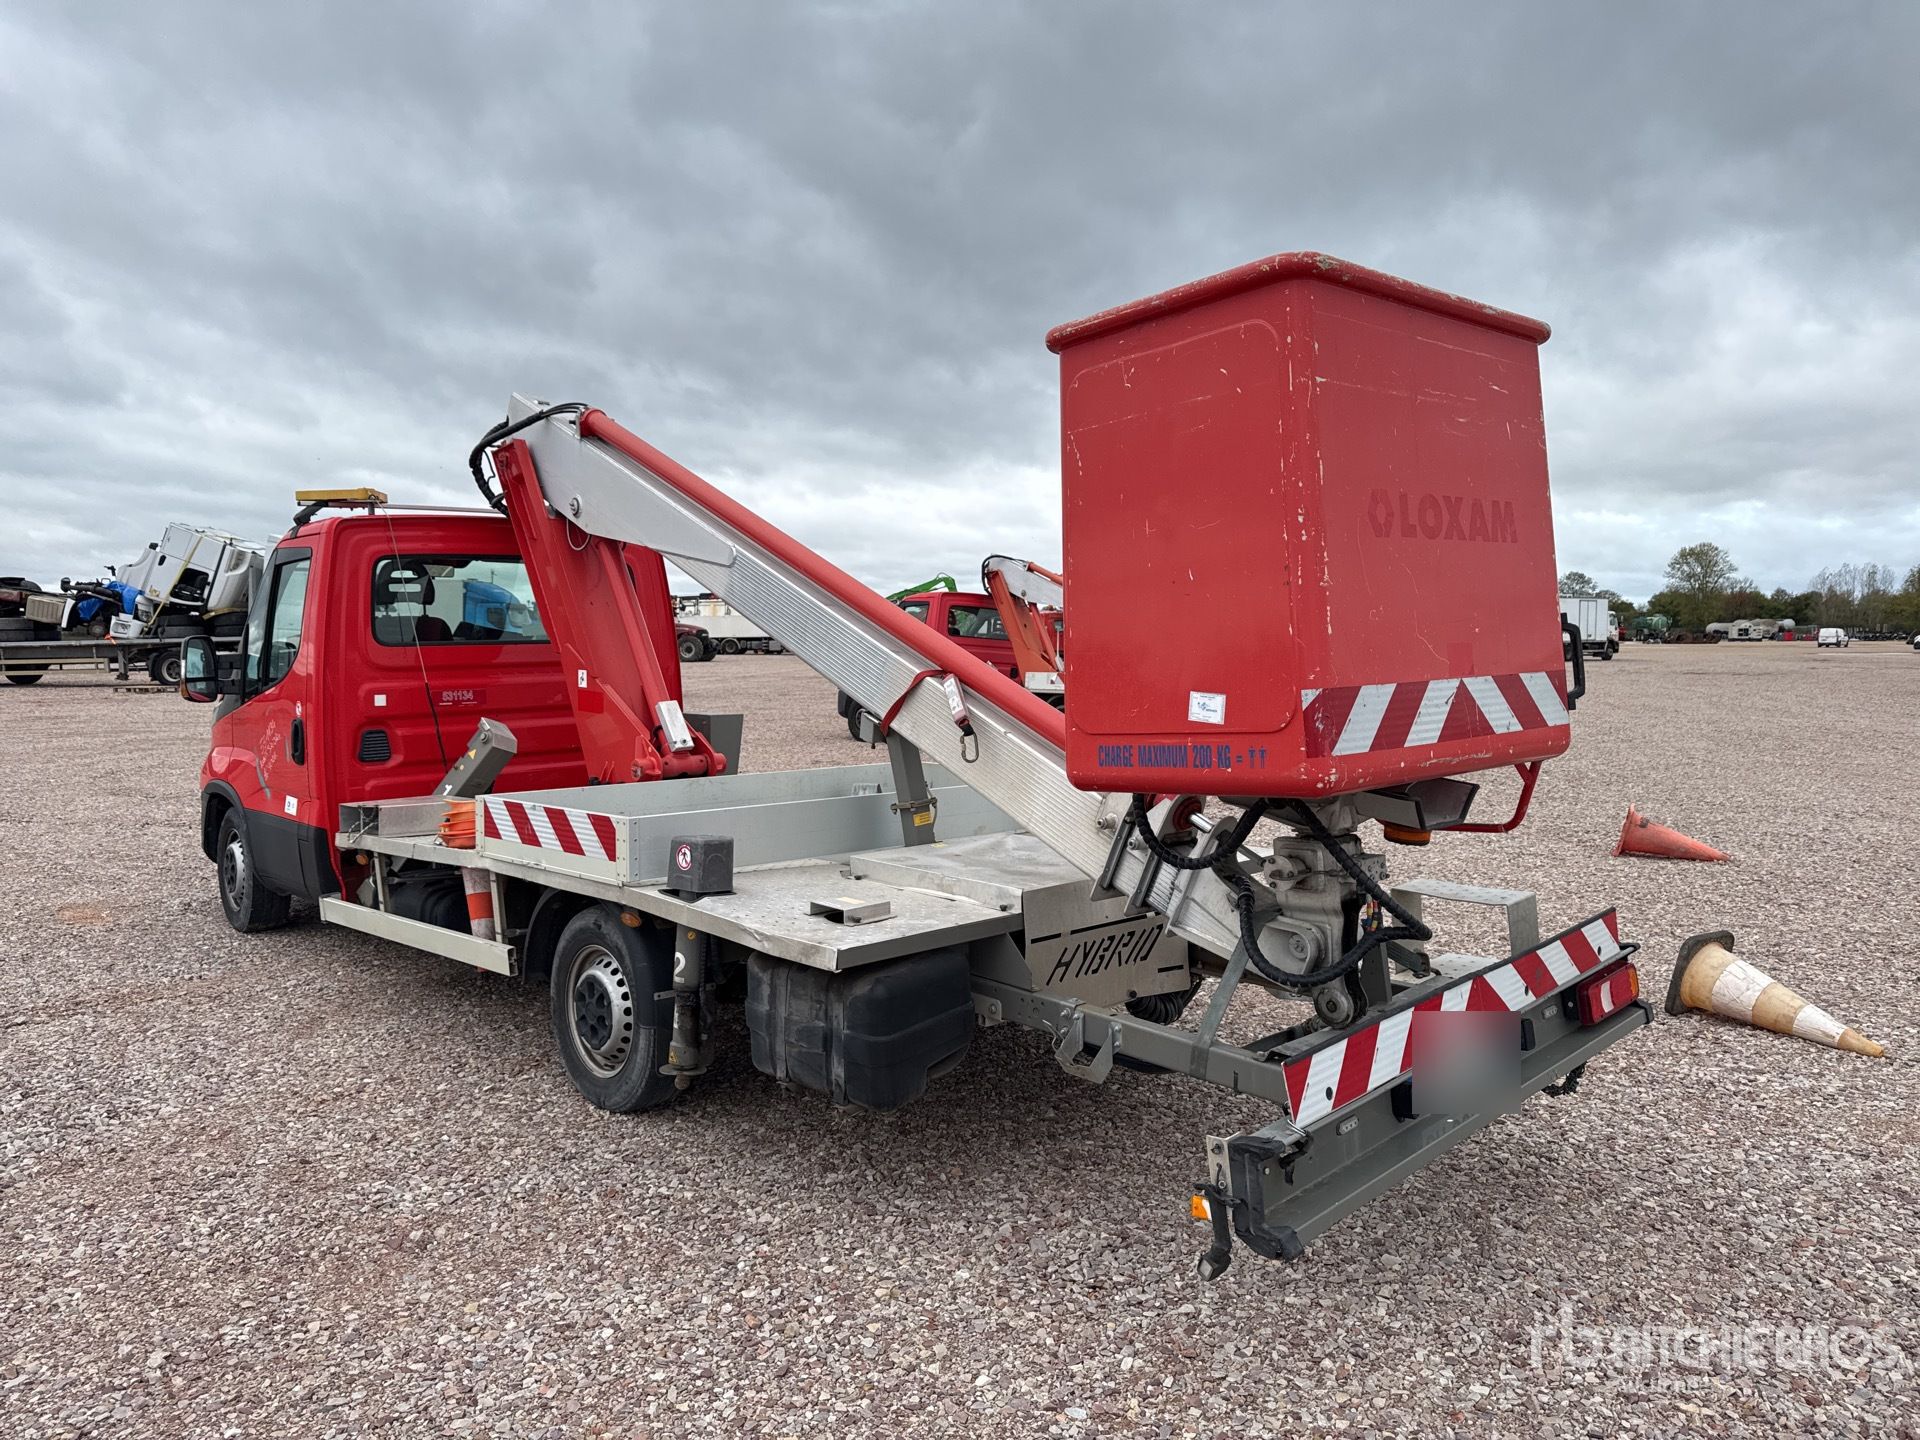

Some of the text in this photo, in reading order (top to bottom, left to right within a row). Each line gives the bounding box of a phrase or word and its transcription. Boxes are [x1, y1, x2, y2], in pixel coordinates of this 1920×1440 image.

[1399, 492, 1518, 543] LOXAM
[1098, 745, 1134, 767] CHARGE
[1138, 745, 1188, 768] MAXIMUM
[1192, 745, 1213, 768] 200
[1217, 745, 1231, 768] KG
[673, 951, 686, 983] 2
[1046, 923, 1164, 986] HYBRID
